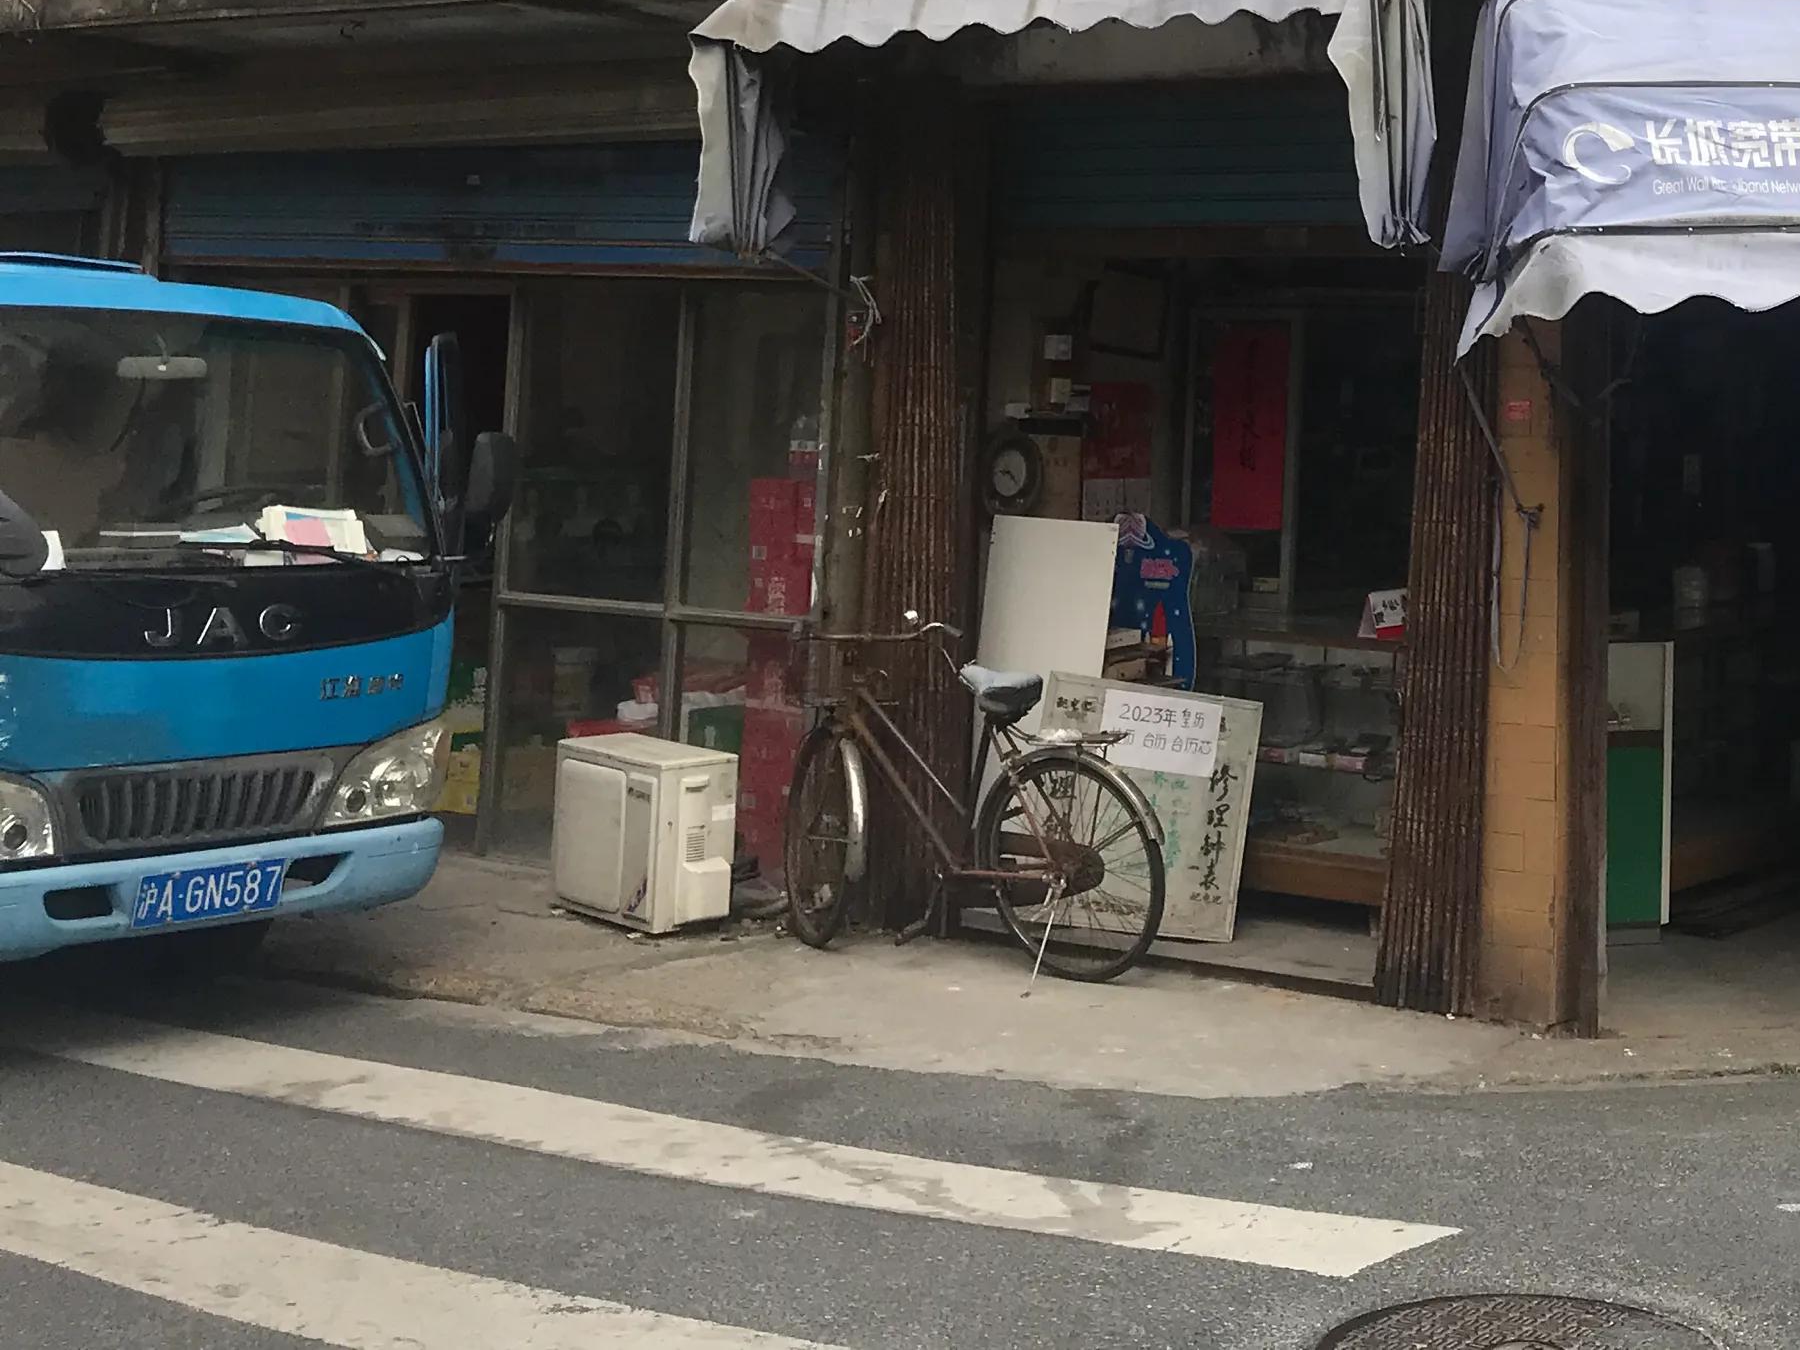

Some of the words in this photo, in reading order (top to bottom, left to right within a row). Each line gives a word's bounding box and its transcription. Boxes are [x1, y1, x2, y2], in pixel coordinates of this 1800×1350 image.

[1653, 179, 1684, 196] Great
[143, 603, 302, 648] JAC
[1118, 703, 1177, 728] 2023年
